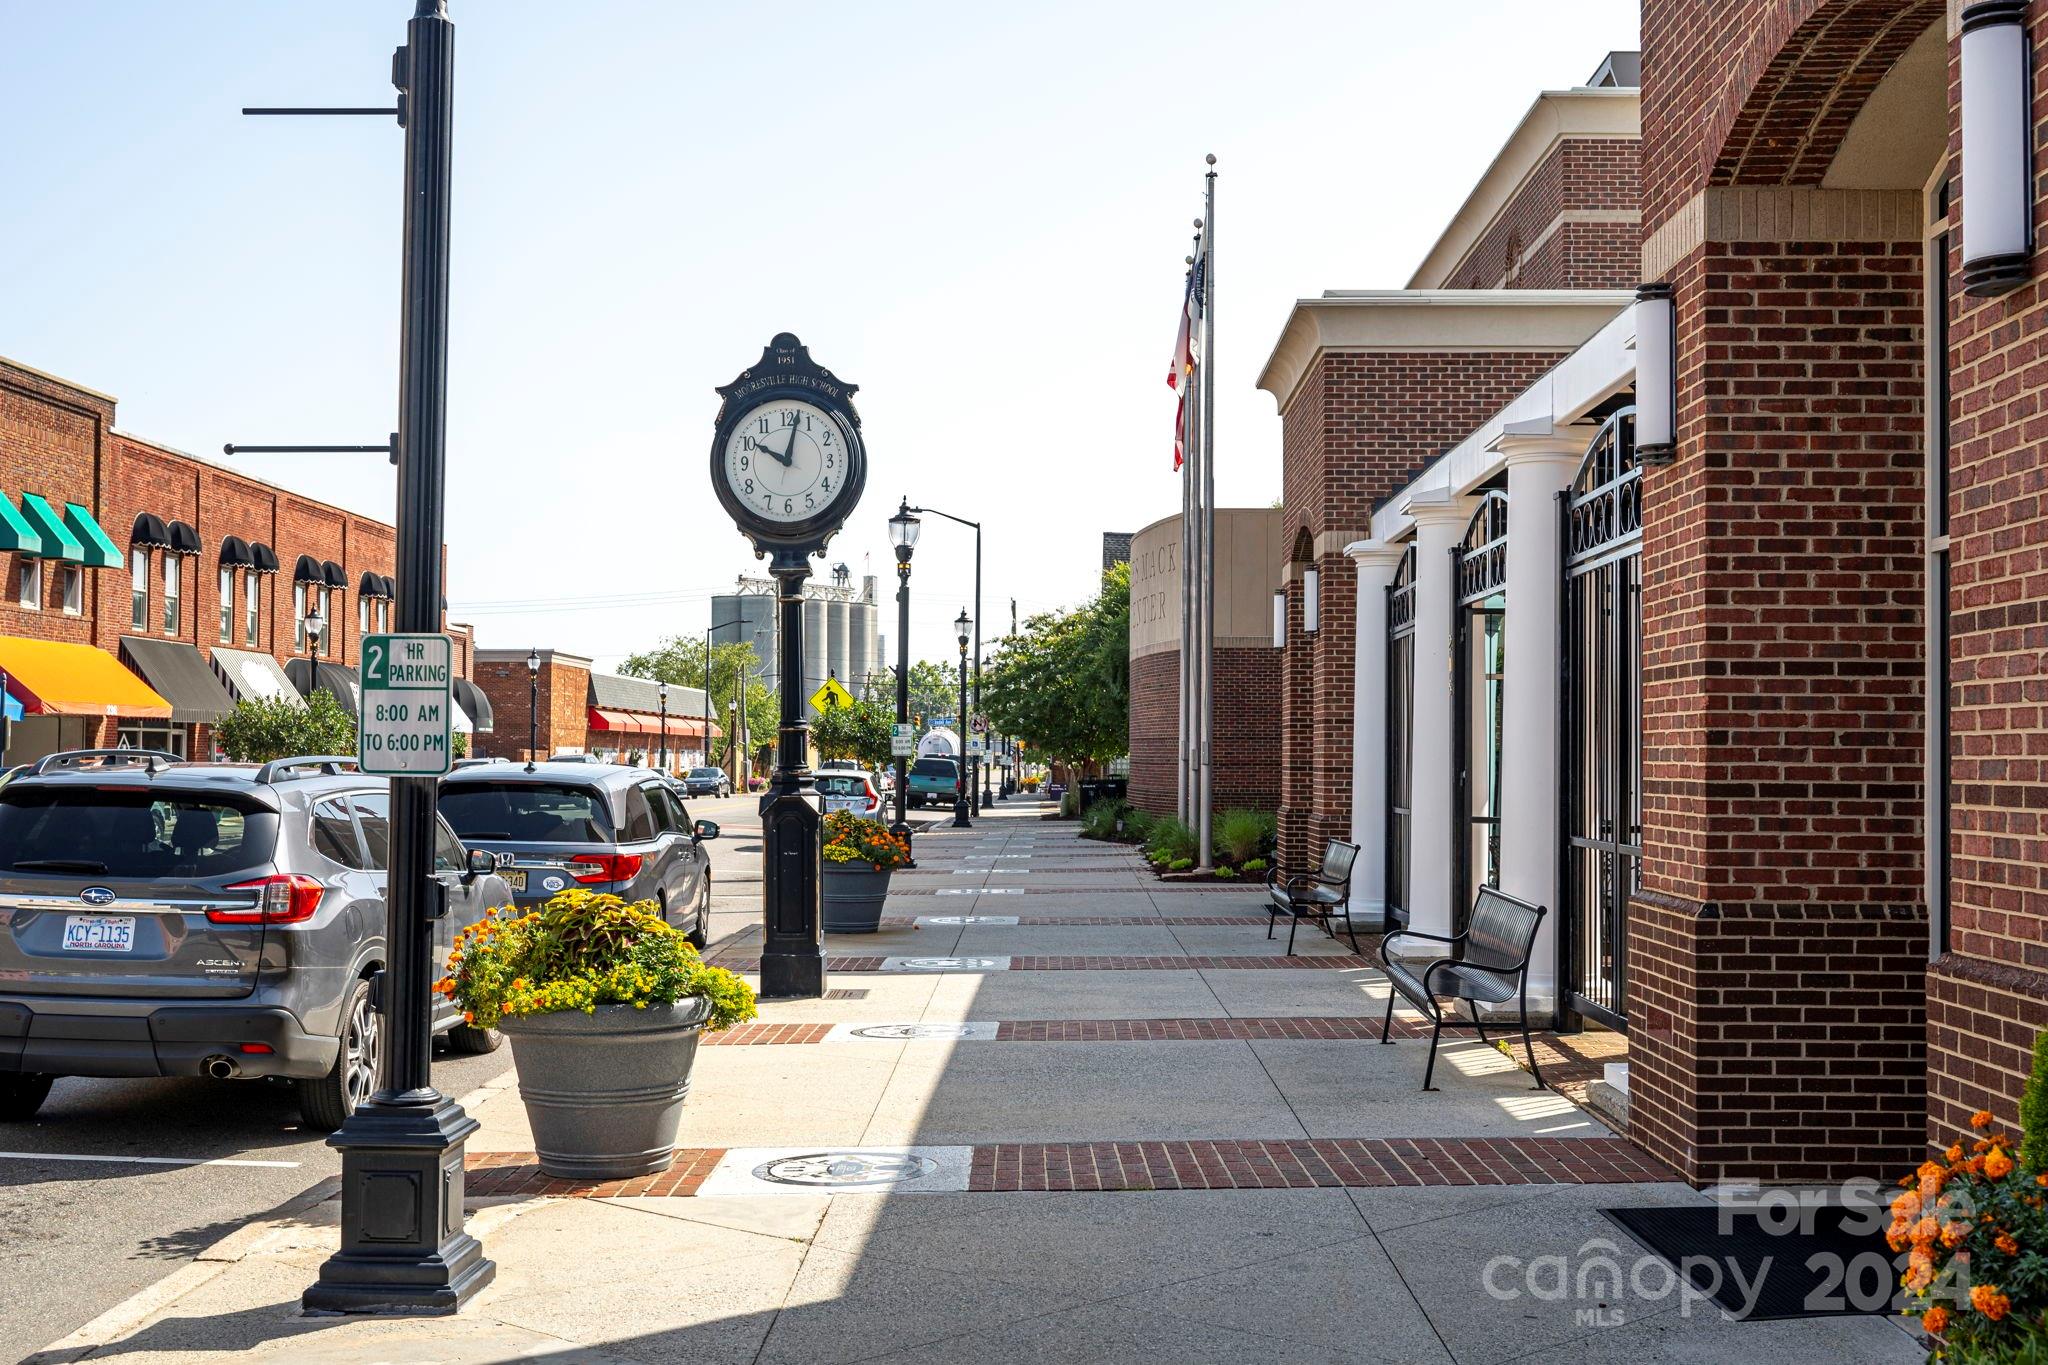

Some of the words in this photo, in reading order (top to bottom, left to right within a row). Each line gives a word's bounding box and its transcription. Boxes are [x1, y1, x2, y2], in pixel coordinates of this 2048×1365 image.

[735, 374, 787, 399] MOORESVILLE
[789, 374, 808, 386] HIGH
[811, 377, 839, 398] SCHOOL
[759, 419, 769, 433] 11
[781, 411, 793, 427] 12
[806, 416, 812, 431] 1
[743, 436, 755, 451] 10
[823, 431, 831, 446] 2
[740, 456, 749, 471] 9
[826, 454, 834, 468] 3
[745, 479, 754, 494] 8
[821, 477, 830, 492] 4
[763, 495, 773, 510] 7
[784, 498, 793, 513] 6
[805, 493, 814, 508] 5
[367, 645, 383, 679] 2
[407, 643, 424, 660] HR
[389, 664, 446, 682] PARKING
[376, 704, 408, 722] 8:00
[417, 704, 439, 722] AM
[893, 726, 898, 735] 2
[365, 733, 382, 751] TO
[387, 733, 419, 752] 6:00
[424, 734, 444, 751] PM
[67, 924, 130, 943] KCY-1135
